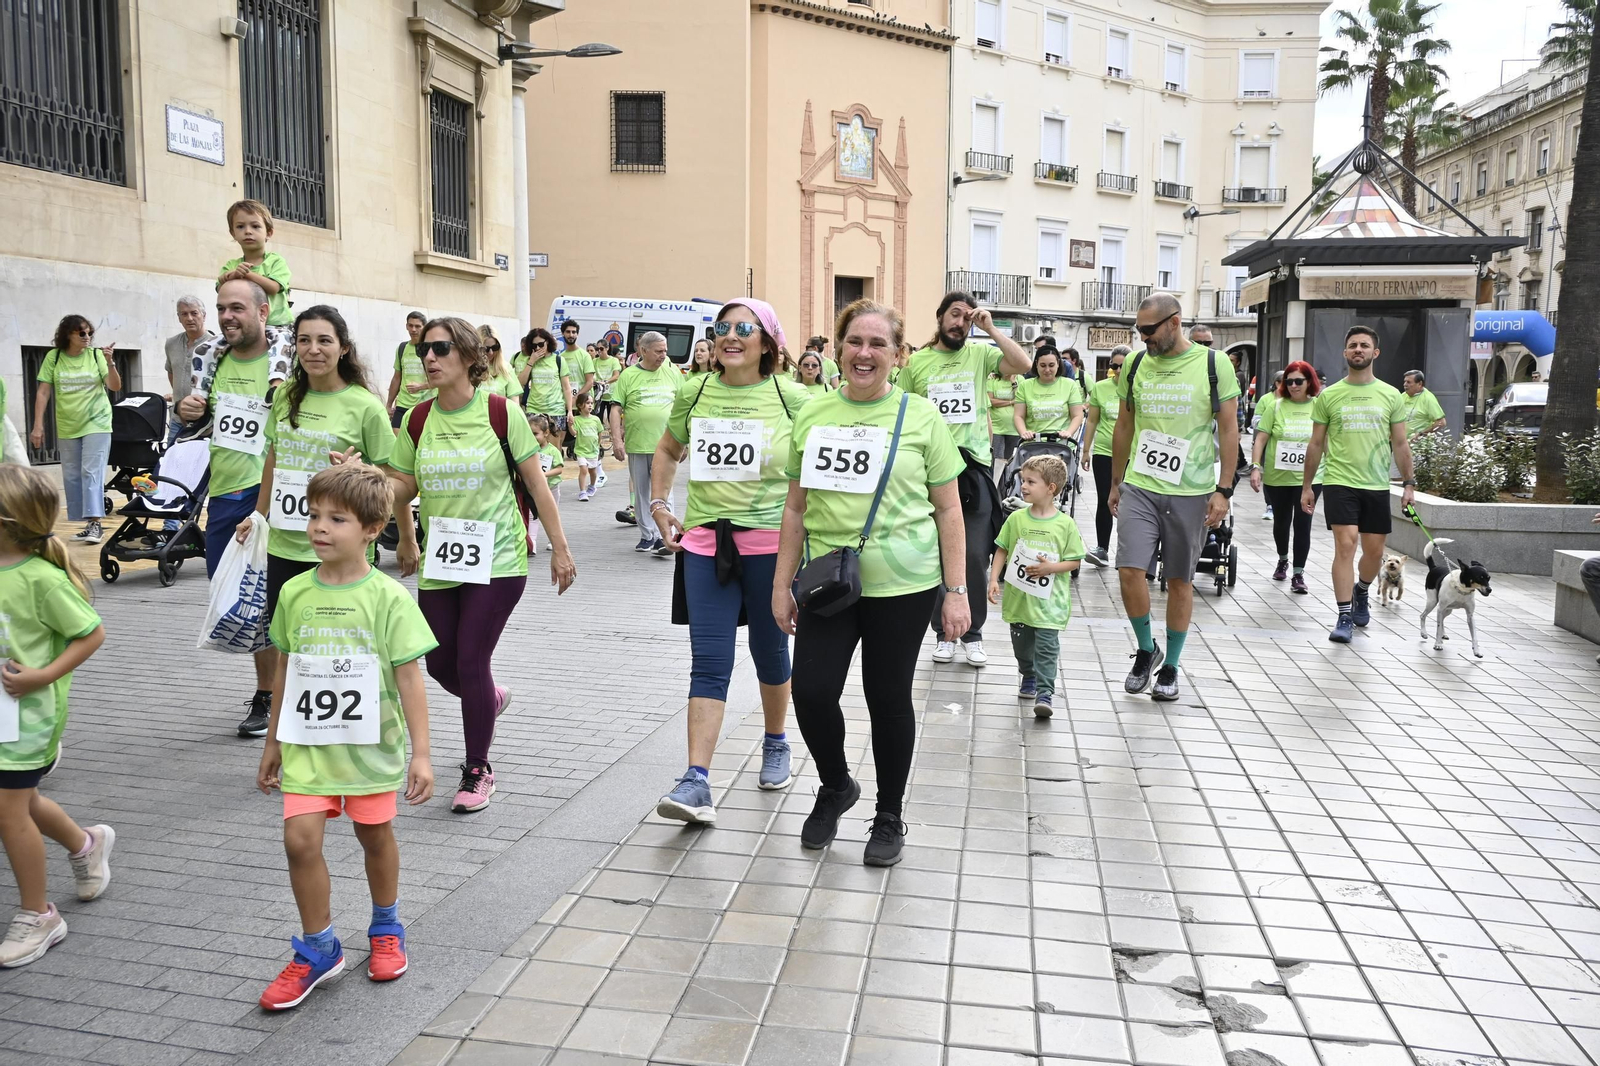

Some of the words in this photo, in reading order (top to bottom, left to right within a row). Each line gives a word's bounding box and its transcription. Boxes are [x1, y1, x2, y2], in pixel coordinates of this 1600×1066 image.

[183, 119, 200, 133] PLAZA
[170, 132, 178, 142] DE
[179, 132, 190, 145] LAS
[191, 136, 213, 151] MONJAS
[1334, 280, 1381, 296] BURGUER
[1382, 280, 1437, 296] FERNANDO
[562, 299, 654, 310] PROTECCION
[658, 302, 697, 313] CIVIL
[1474, 317, 1524, 334] original
[1102, 330, 1128, 345] TRAVIESA
[1142, 381, 1154, 390] En
[1156, 381, 1195, 392] marcha
[1140, 392, 1178, 402] contra
[1180, 392, 1192, 403] el
[1141, 401, 1192, 415] cáncer
[219, 414, 260, 439] 699
[276, 422, 291, 434] En
[1343, 420, 1381, 430] cáncer
[421, 448, 434, 459] En
[437, 446, 486, 458] marcha
[421, 461, 467, 474] contra
[469, 459, 486, 473] el
[815, 446, 871, 476] 558
[422, 475, 487, 492] cáncer
[435, 541, 483, 567] 493
[300, 624, 316, 638] En
[318, 625, 374, 643] marcha
[300, 641, 353, 655] contra
[355, 641, 374, 655] el
[296, 689, 364, 722] 492
